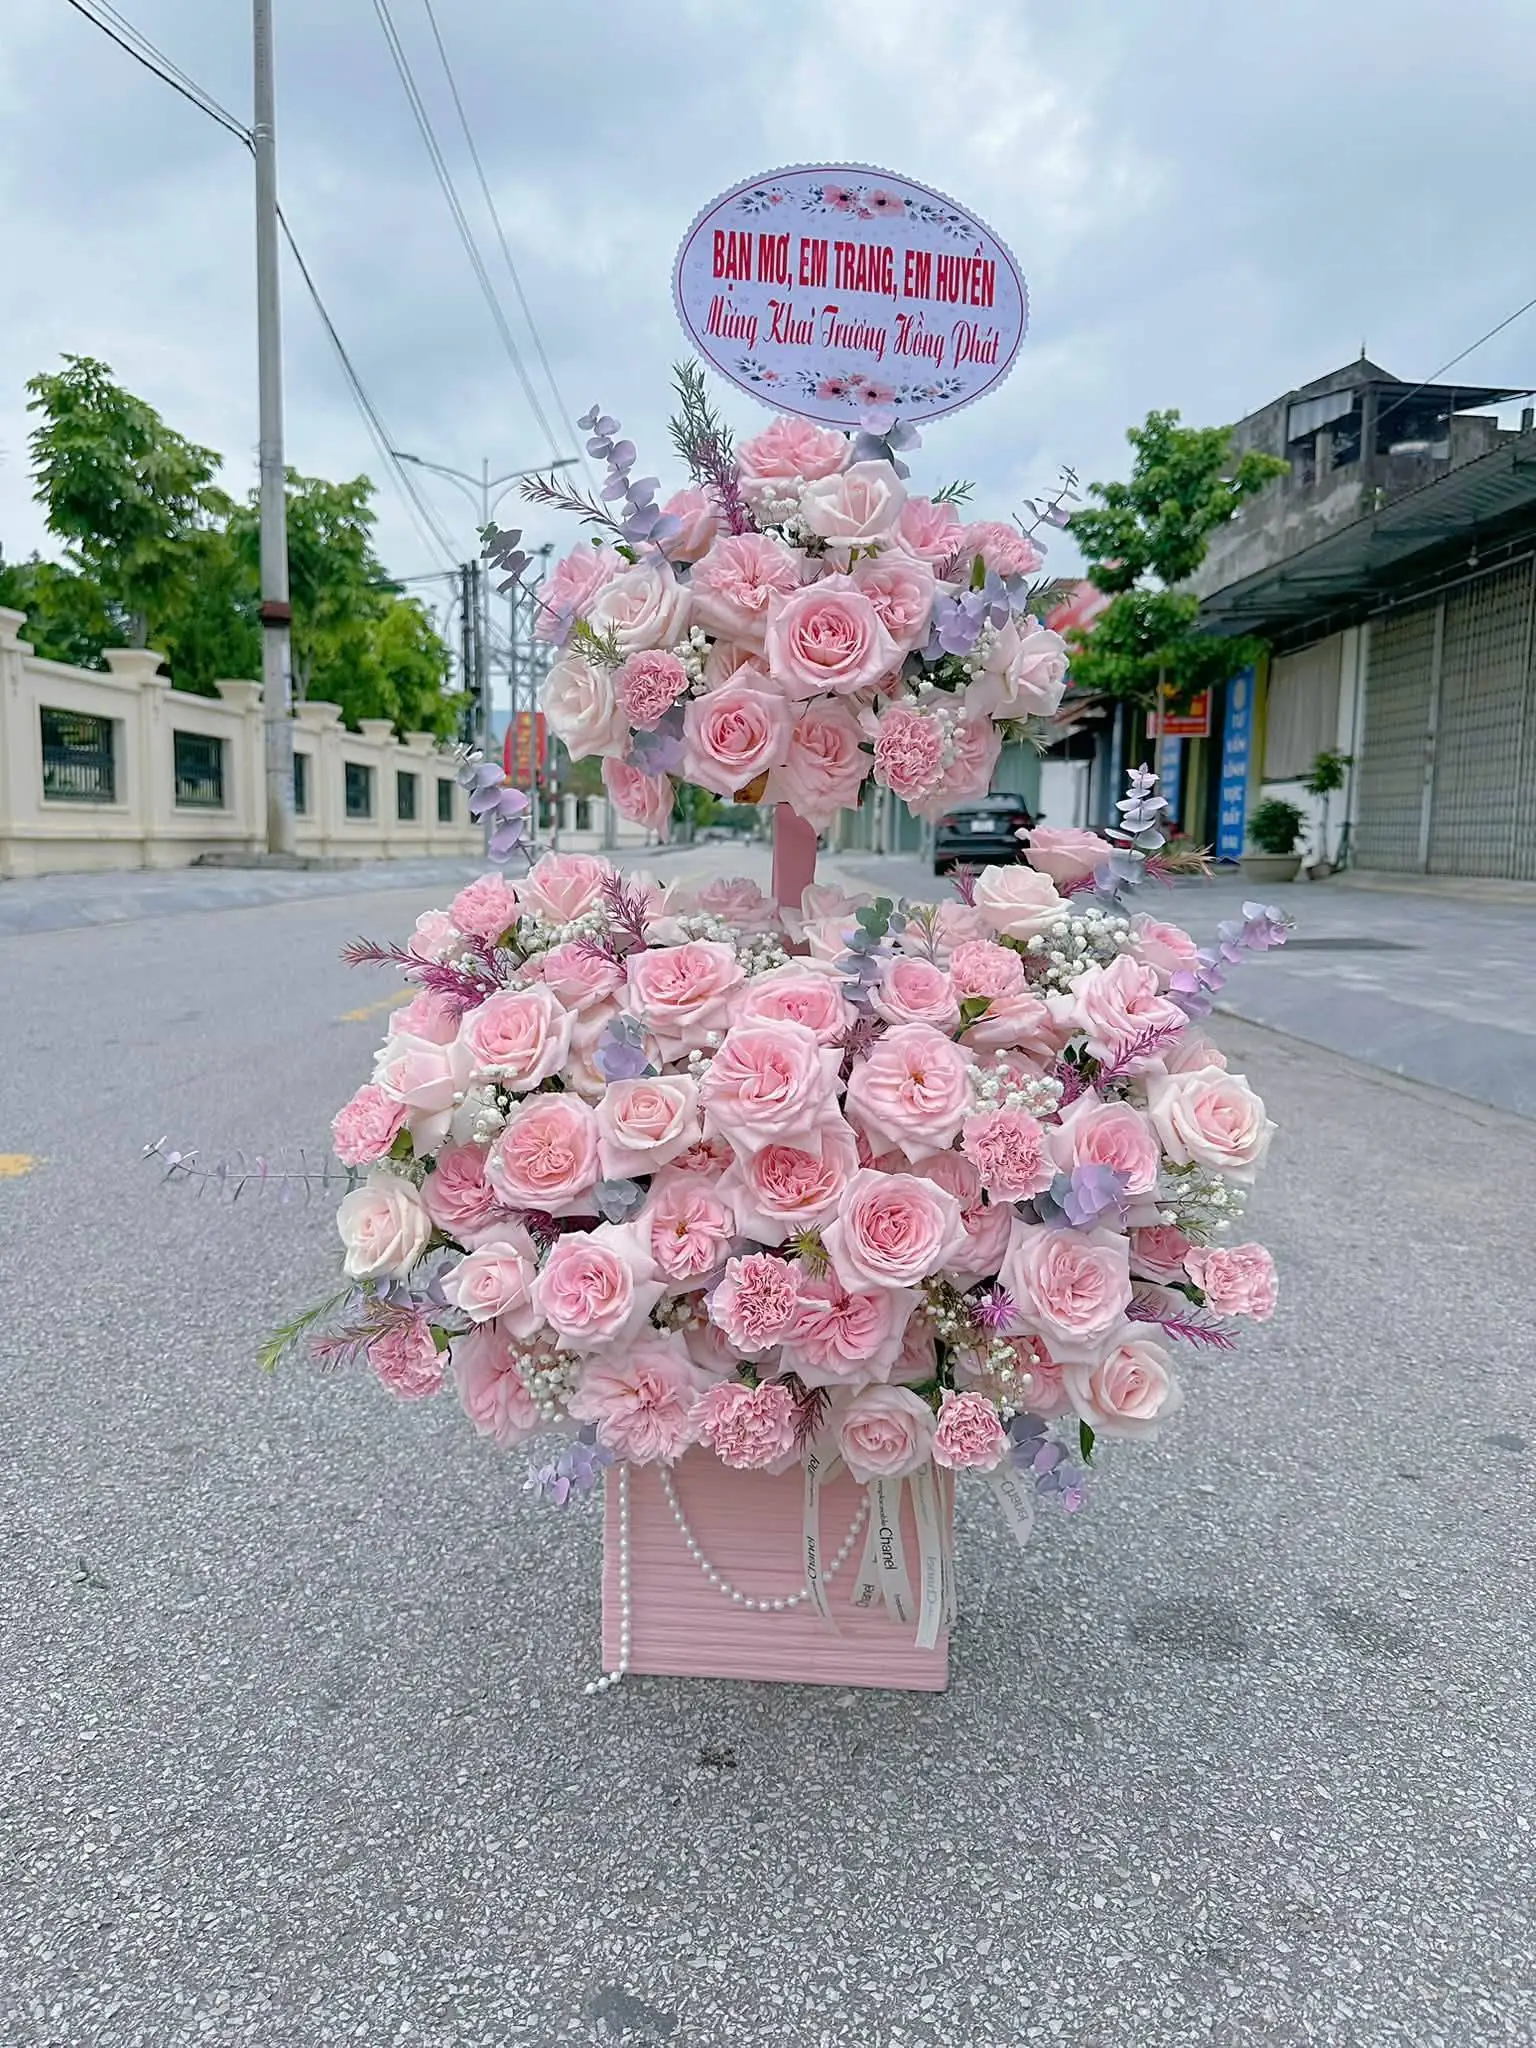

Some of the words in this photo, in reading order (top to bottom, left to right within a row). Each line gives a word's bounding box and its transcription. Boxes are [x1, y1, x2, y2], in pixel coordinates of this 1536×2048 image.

[713, 229, 753, 292] BẠN
[757, 232, 793, 292] MƠ,
[799, 237, 828, 288] EM
[833, 241, 898, 303] TRANG,
[903, 249, 933, 300] EM
[936, 240, 997, 308] HUYỀN
[702, 294, 759, 351] Mừng
[762, 298, 816, 346] Khai
[893, 311, 945, 369] Hồng
[951, 319, 1001, 371] Phát
[806, 1535, 818, 1581] Chanel
[879, 1527, 898, 1570] Chanel
